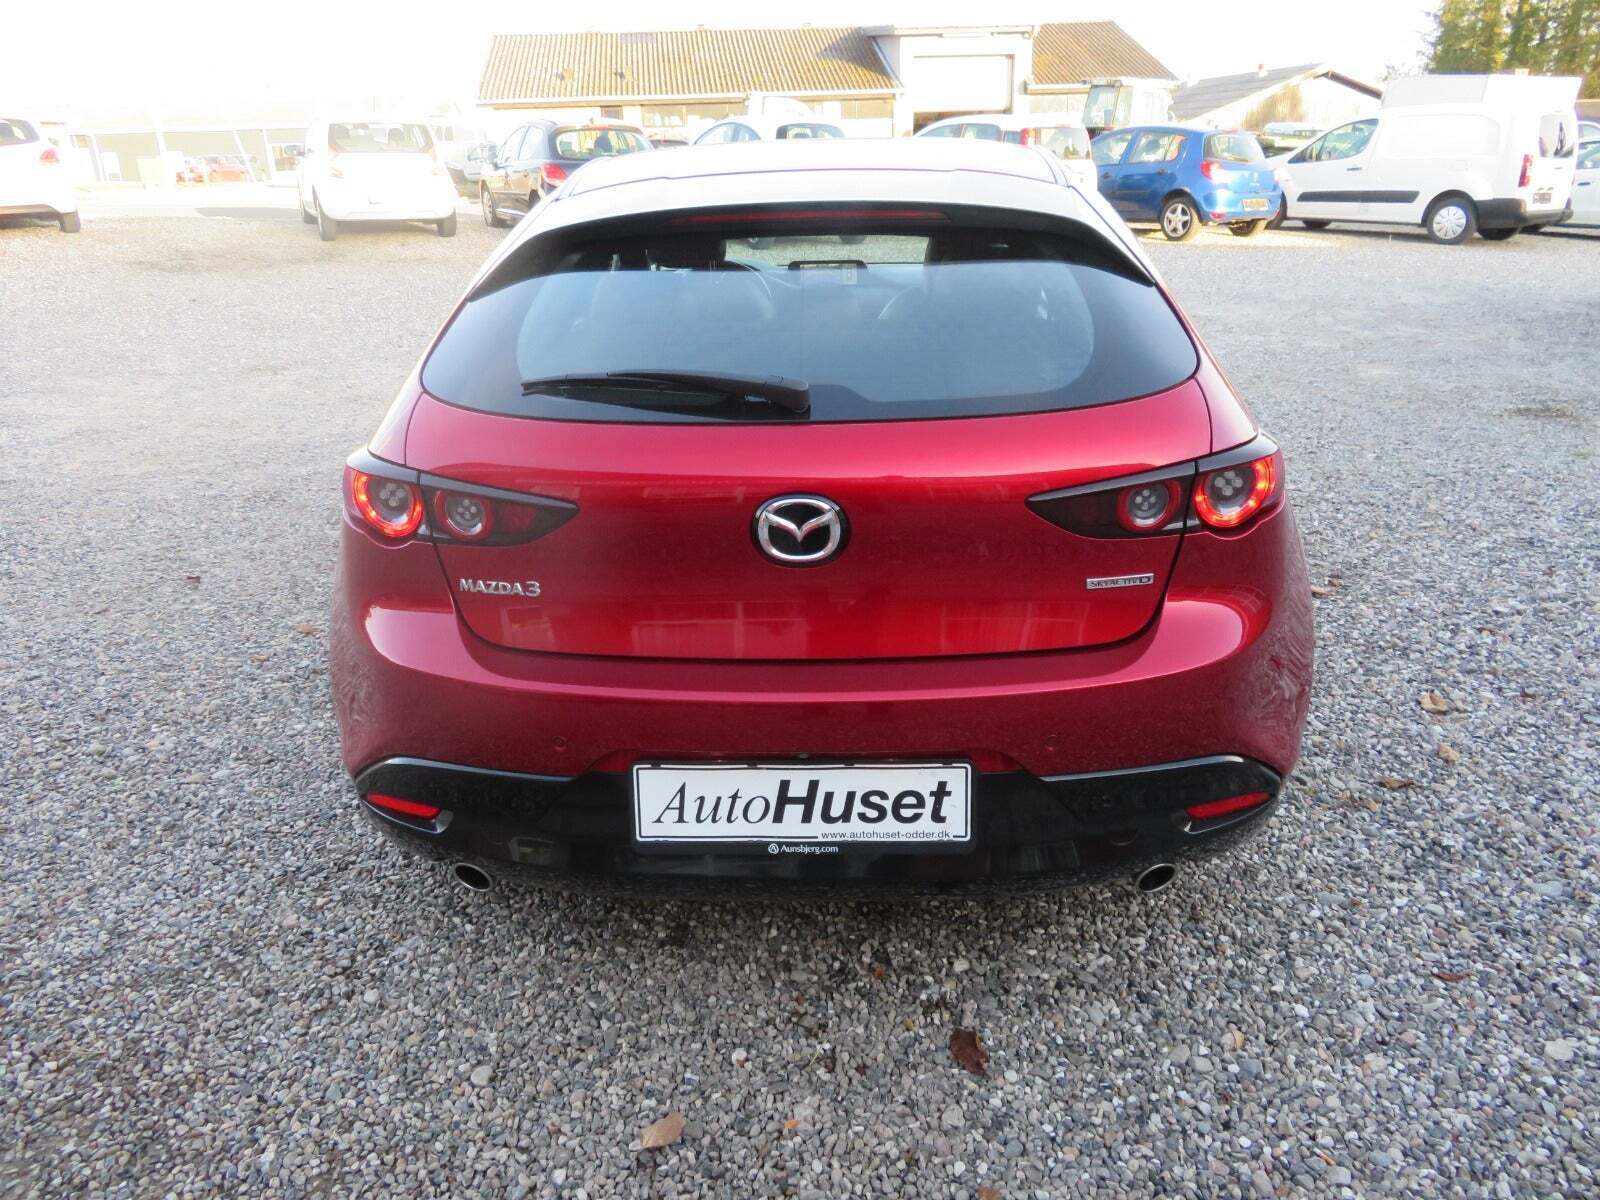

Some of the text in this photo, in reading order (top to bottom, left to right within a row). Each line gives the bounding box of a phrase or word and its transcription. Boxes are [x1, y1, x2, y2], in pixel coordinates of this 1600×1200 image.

[459, 578, 541, 597] MAZDA3
[821, 830, 950, 839] www.autohuset-odder.dk
[780, 844, 839, 854] Aunsbjerg.com
